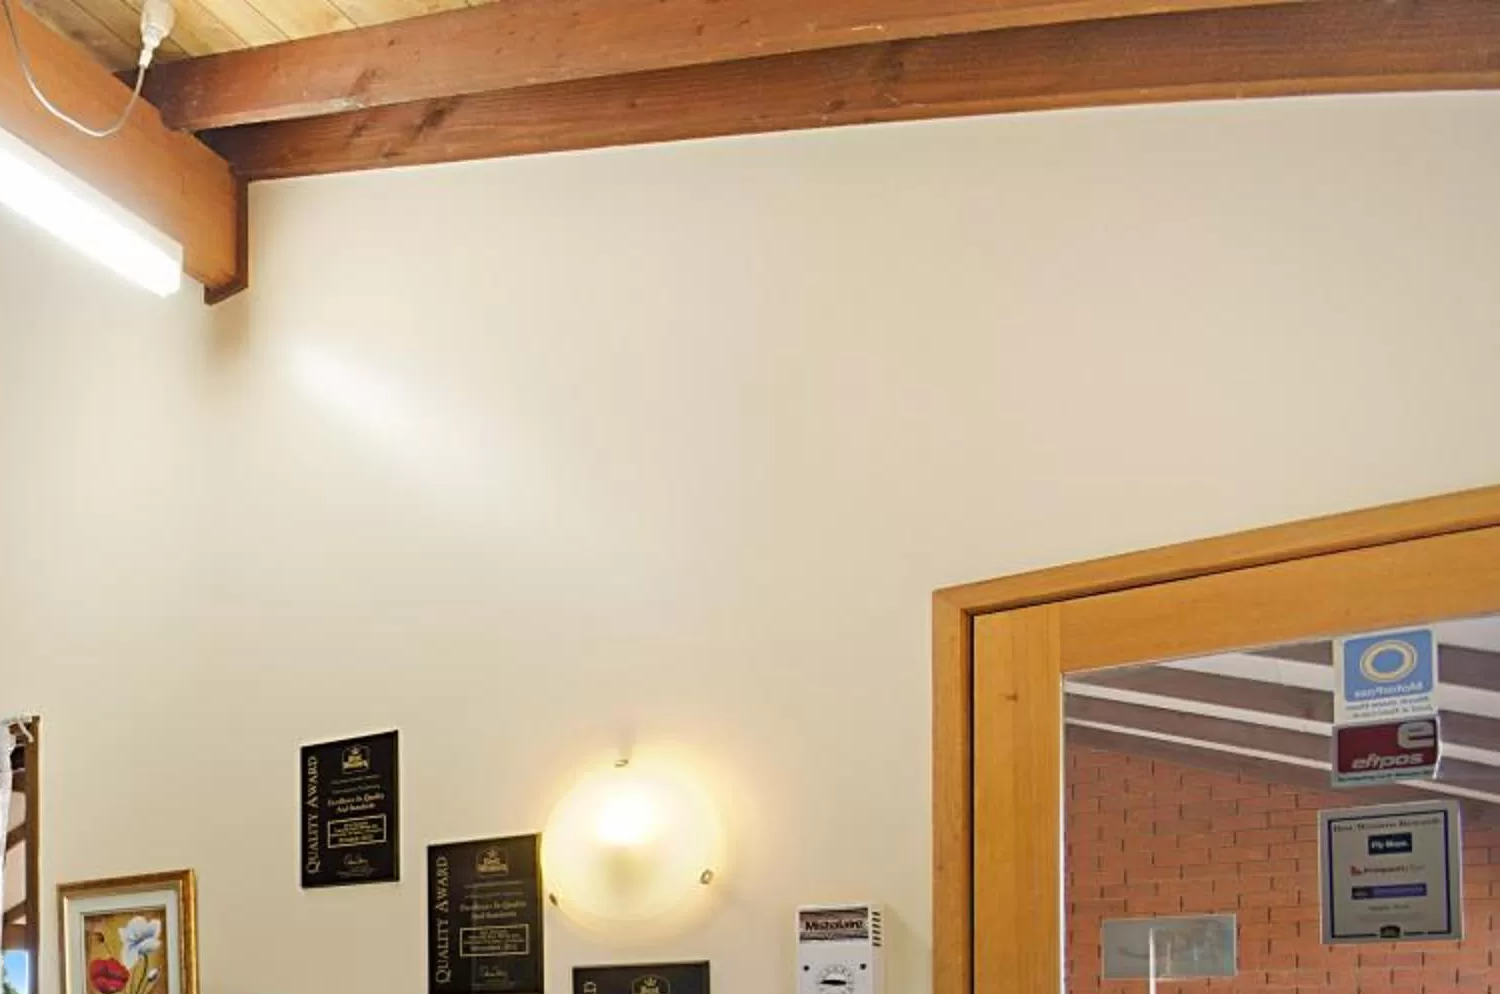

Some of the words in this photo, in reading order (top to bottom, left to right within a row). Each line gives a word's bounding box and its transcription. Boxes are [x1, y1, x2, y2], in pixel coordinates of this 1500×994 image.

[306, 755, 320, 808] AWARD
[1351, 752, 1425, 769] eftpos
[306, 813, 321, 875] QUALITY
[435, 857, 449, 911] AWARD
[436, 918, 450, 984] QUALITY
